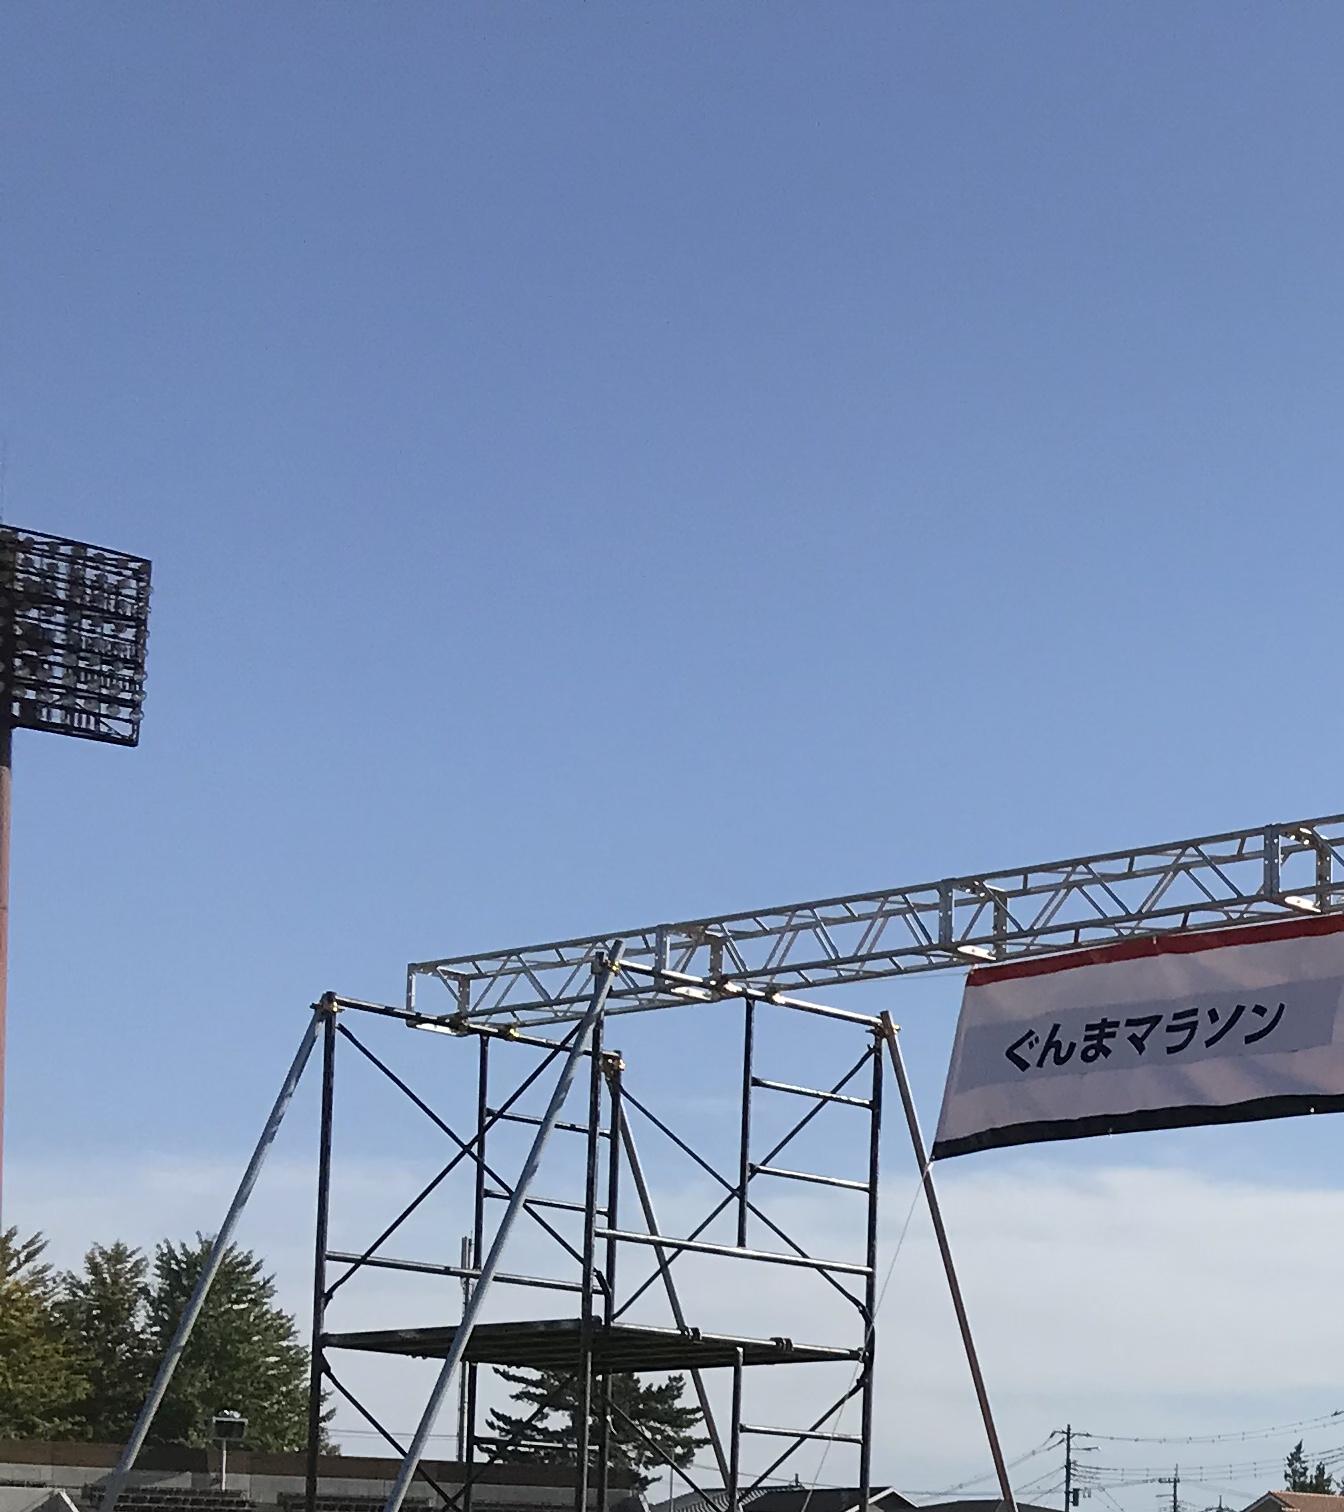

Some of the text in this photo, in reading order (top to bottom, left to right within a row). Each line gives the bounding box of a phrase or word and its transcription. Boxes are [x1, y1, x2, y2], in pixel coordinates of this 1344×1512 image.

[1003, 1002, 1287, 1073] ぐんまマラソン
